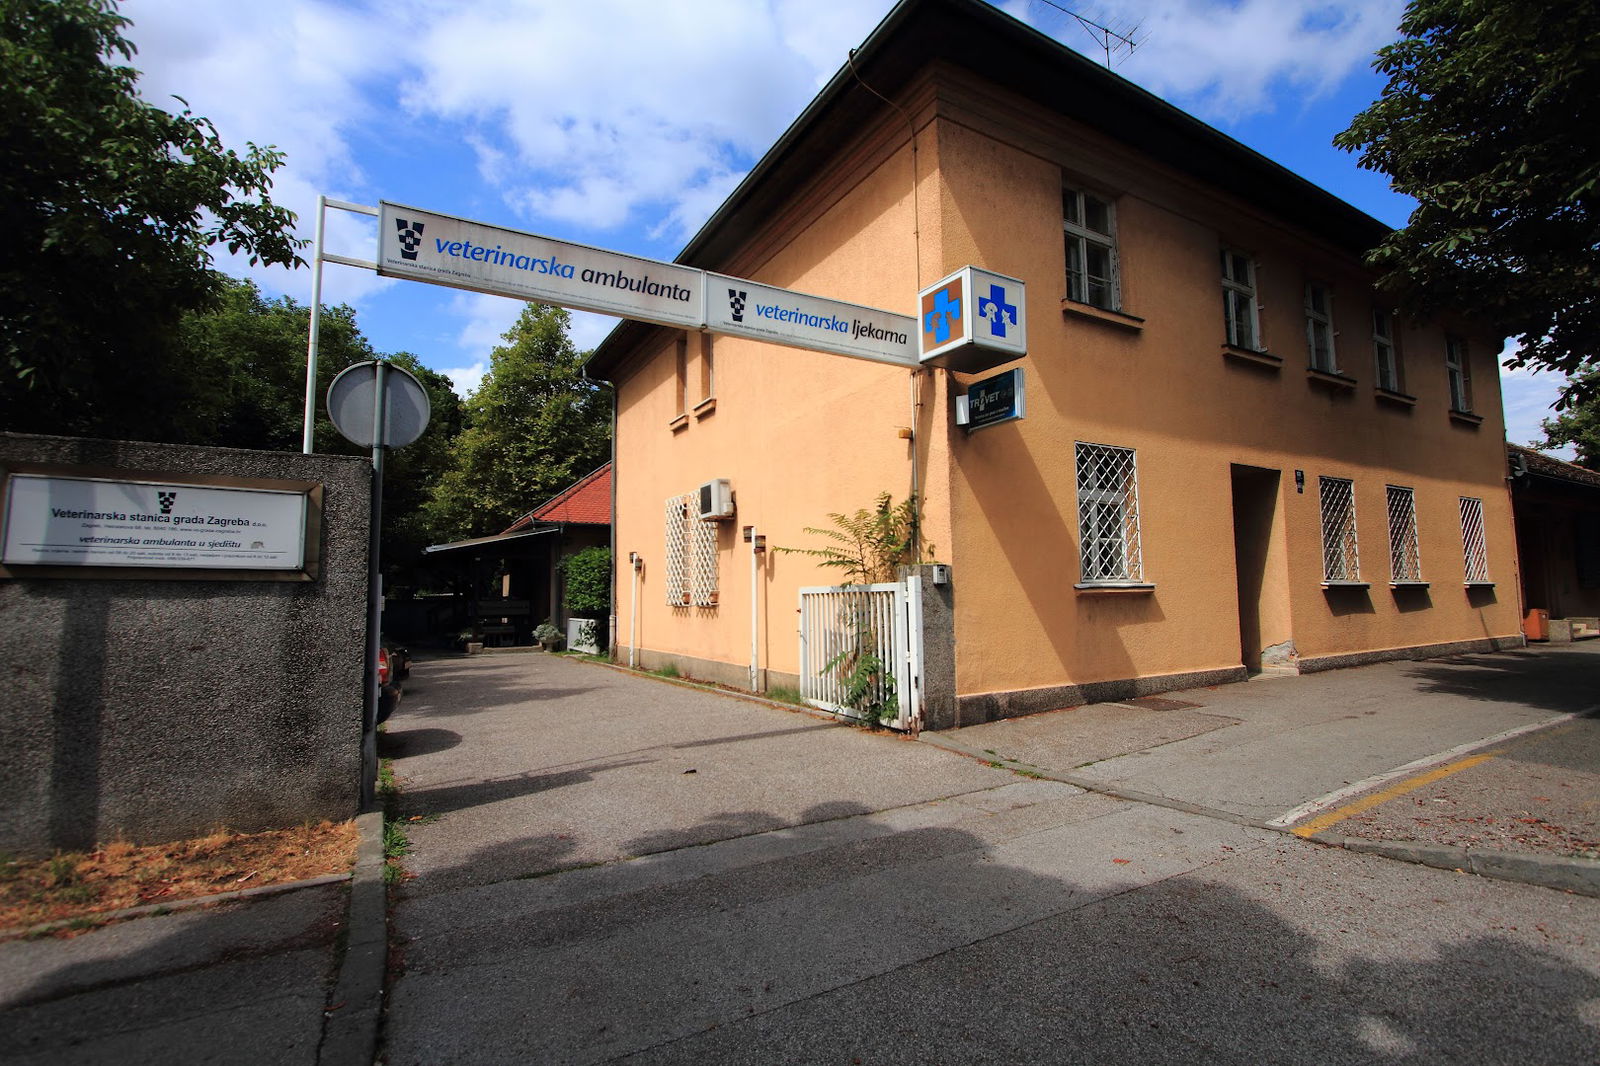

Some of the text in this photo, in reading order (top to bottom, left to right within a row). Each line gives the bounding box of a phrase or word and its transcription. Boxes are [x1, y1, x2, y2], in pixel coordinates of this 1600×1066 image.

[436, 237, 575, 279] veterinarska
[581, 268, 691, 302] ambulanta
[756, 303, 907, 345] veterinarska ljekarna
[52, 507, 126, 521] Veterinarska
[129, 512, 170, 523] stanica
[173, 515, 204, 525] grada
[207, 516, 250, 528] Zagreba
[79, 536, 140, 545] veterinarska
[142, 537, 196, 547] ambulanta
[208, 540, 241, 549] sjedištu
